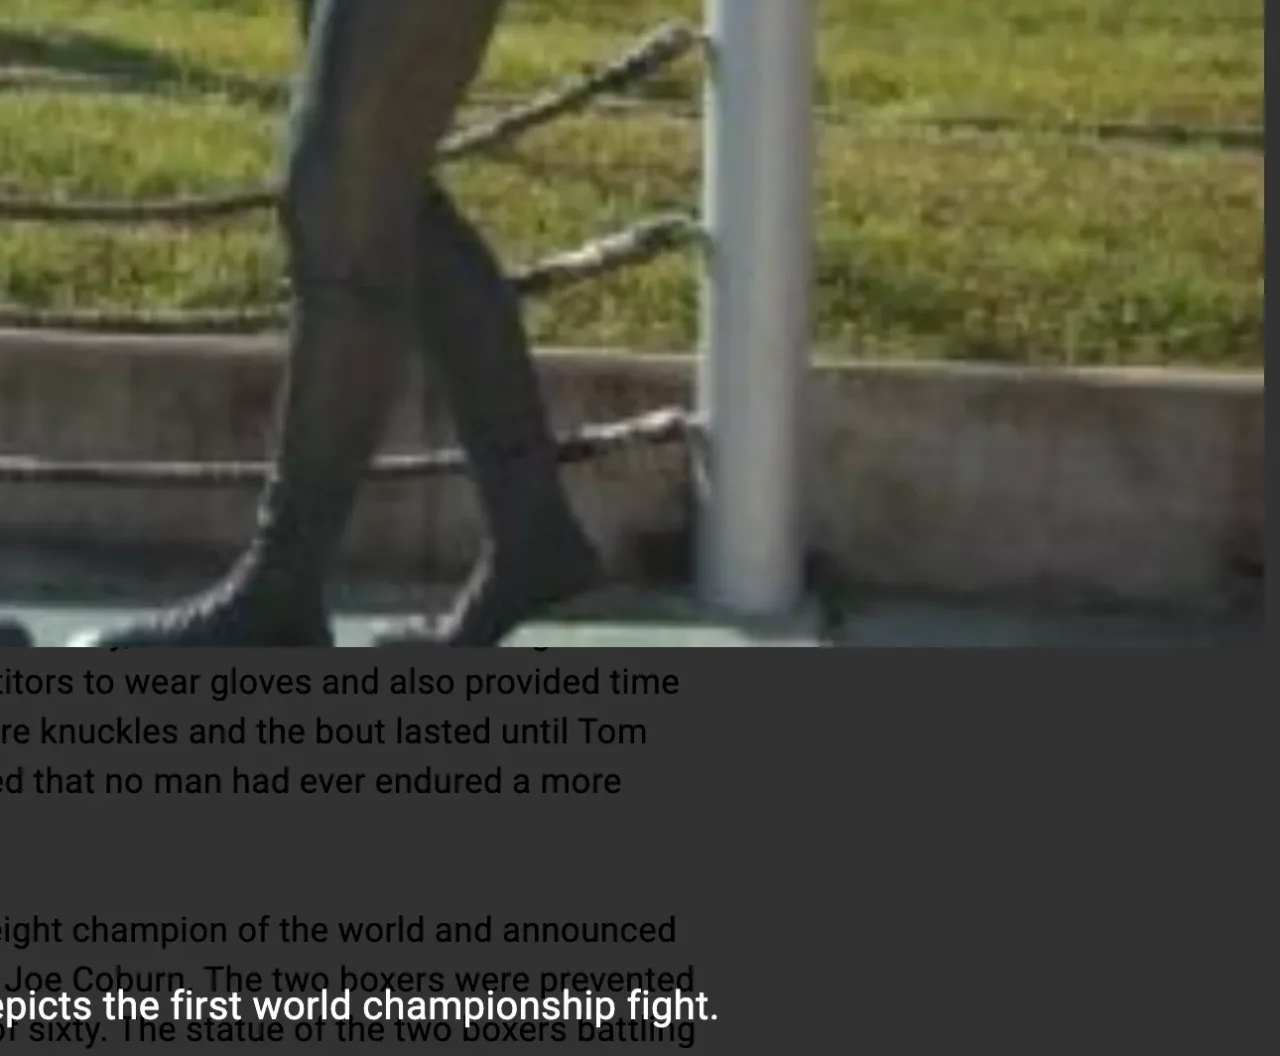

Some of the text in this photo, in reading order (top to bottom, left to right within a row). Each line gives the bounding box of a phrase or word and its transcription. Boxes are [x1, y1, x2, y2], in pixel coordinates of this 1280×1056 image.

[82, 669, 114, 695] to
[124, 674, 201, 695] wear
[210, 666, 312, 702] gloves
[322, 666, 379, 695] and
[390, 666, 455, 695] also
[466, 666, 599, 702] provided
[609, 667, 680, 695] time
[41, 716, 178, 745] knuckles
[189, 716, 246, 745] and
[255, 716, 306, 745] the
[316, 716, 386, 745] bout
[396, 716, 490, 745] lasted
[502, 716, 568, 745] until
[577, 717, 647, 745] Tom
[32, 765, 95, 794] that
[105, 773, 143, 794] no
[154, 773, 222, 794] man
[233, 765, 289, 794] had
[300, 773, 366, 794] ever
[375, 765, 502, 794] endured
[513, 773, 530, 794] a
[541, 773, 621, 794] more
[72, 915, 227, 950] champion
[238, 914, 271, 943] of
[278, 914, 329, 943] the
[337, 914, 424, 943] world
[435, 914, 492, 943] and
[503, 914, 676, 943] announced
[4, 965, 63, 994] Joe
[203, 964, 263, 994] The
[271, 967, 330, 994] two
[340, 964, 444, 994] boxers
[454, 971, 530, 994] were
[540, 964, 694, 1001] prevented
[28, 1015, 107, 1050] sixty.
[120, 1015, 176, 1043] The
[186, 1015, 285, 1043] statue
[334, 1015, 385, 1043] the
[393, 1015, 452, 1043] two
[463, 1015, 567, 1043] boxers
[578, 1015, 695, 1050] battling
